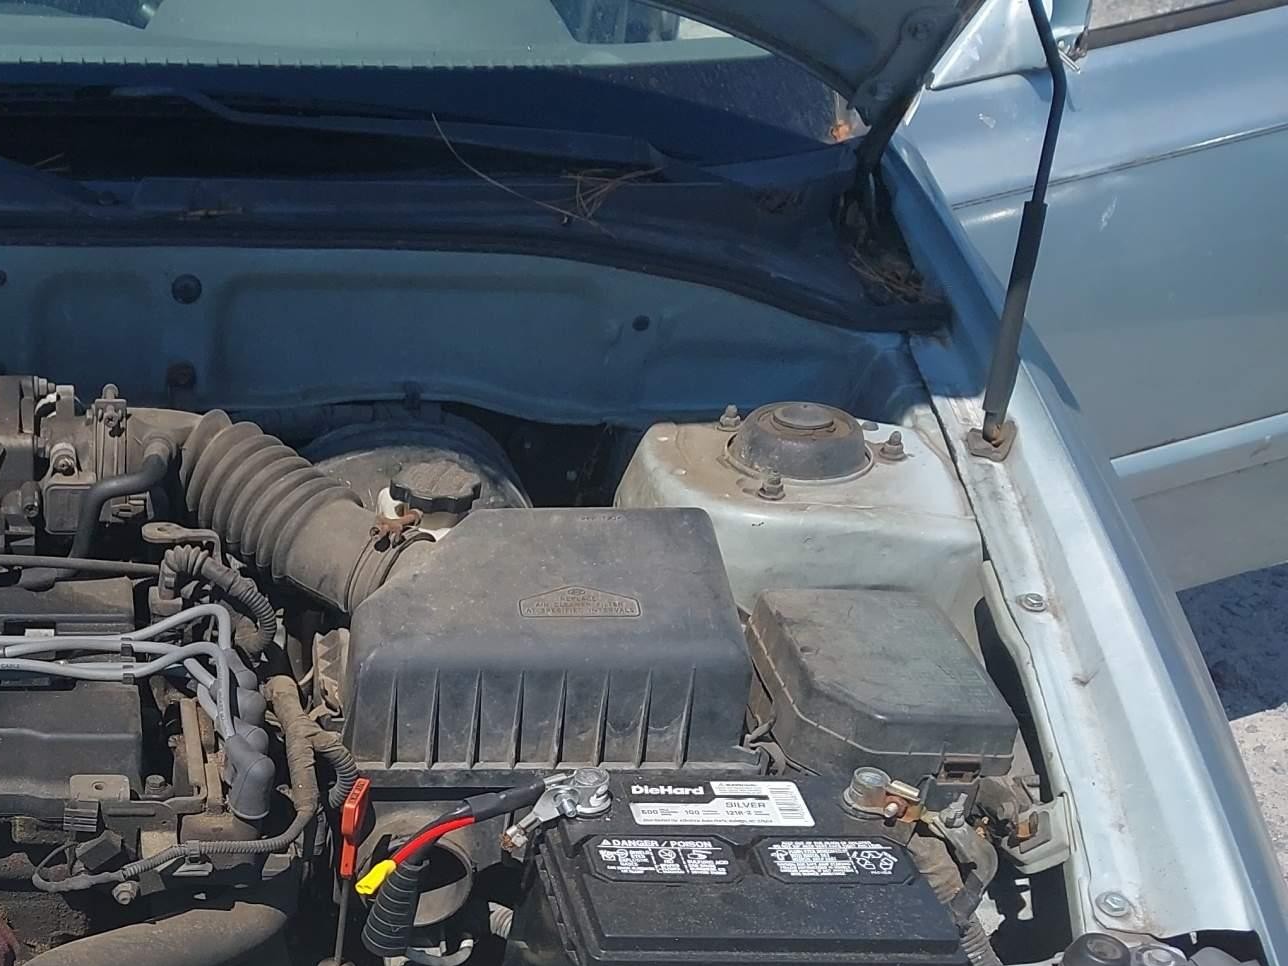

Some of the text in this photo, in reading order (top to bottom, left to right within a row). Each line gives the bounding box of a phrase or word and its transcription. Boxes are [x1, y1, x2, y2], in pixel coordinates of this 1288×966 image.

[631, 784, 705, 795] DieHard
[612, 839, 659, 847] DANGER
[669, 840, 713, 848] POISON
